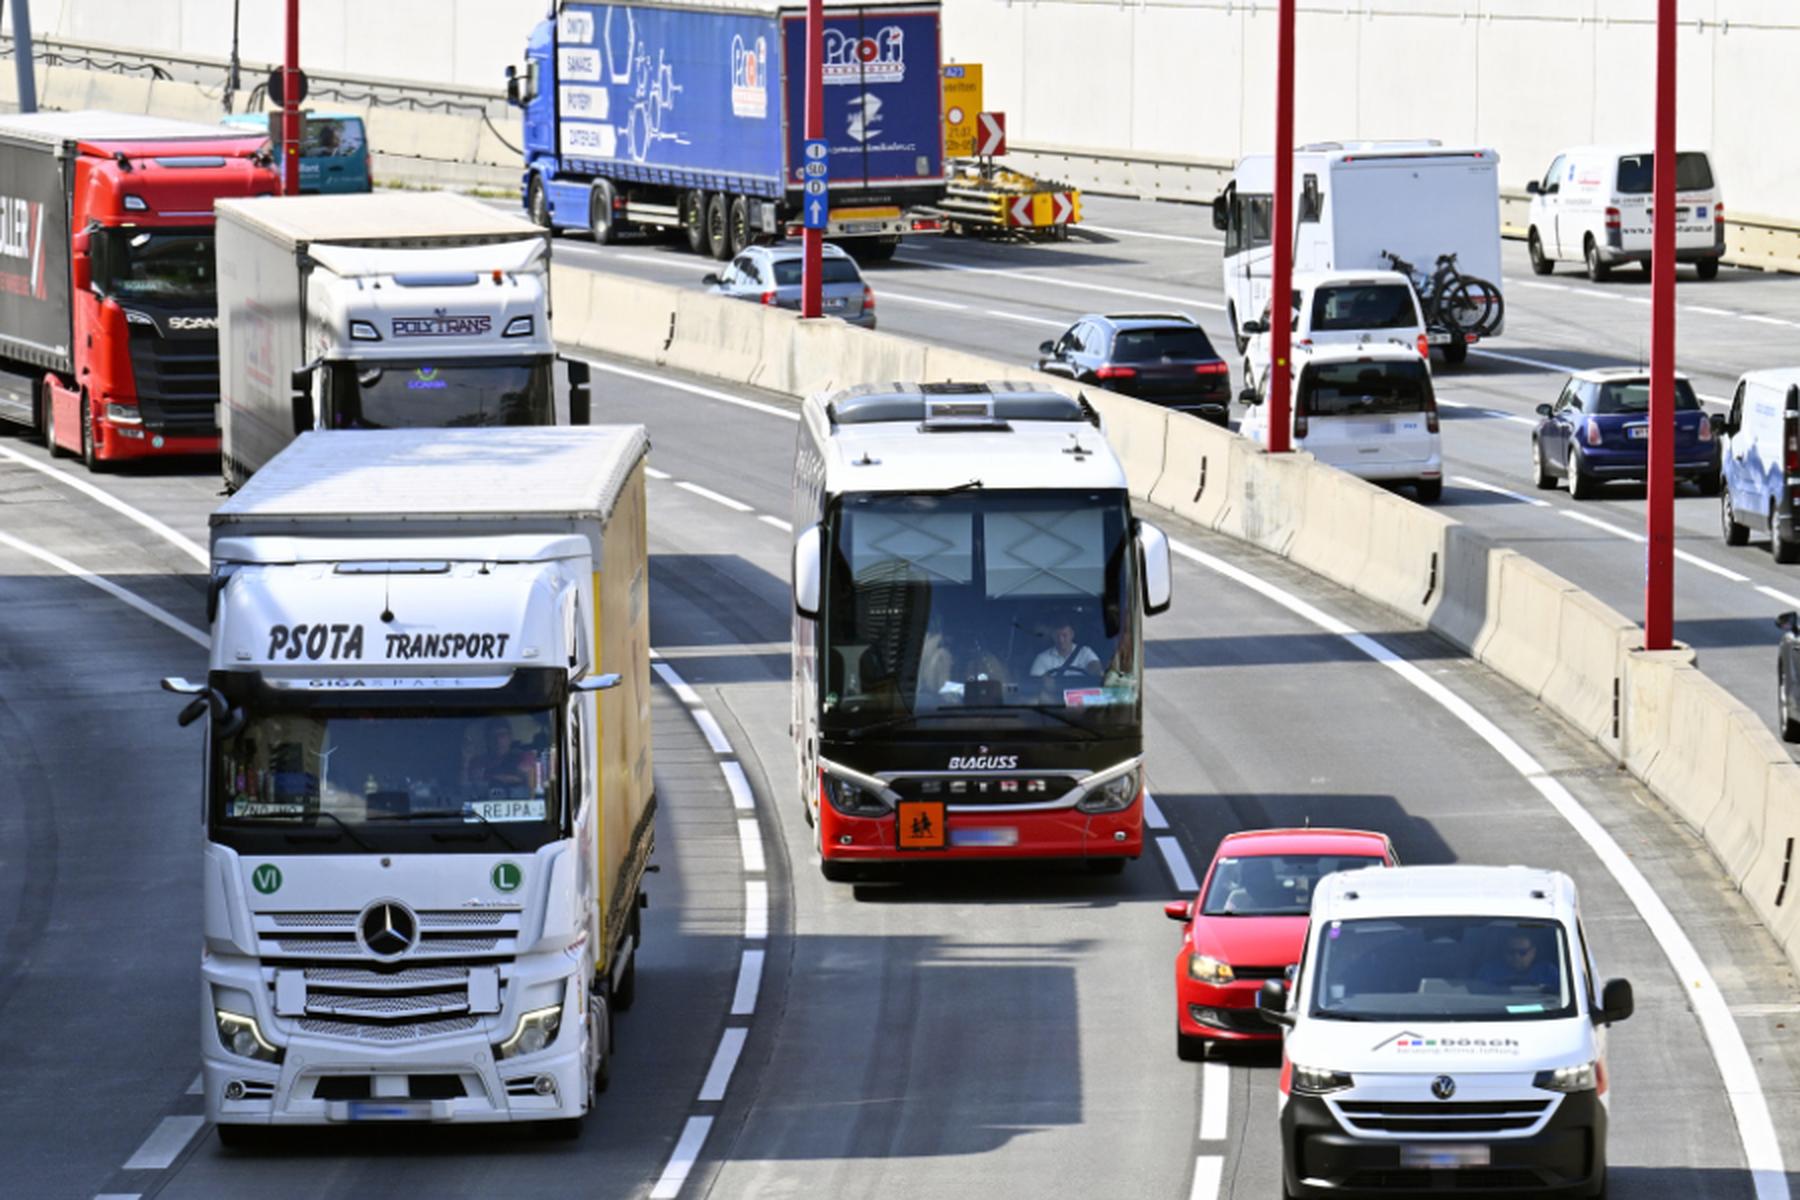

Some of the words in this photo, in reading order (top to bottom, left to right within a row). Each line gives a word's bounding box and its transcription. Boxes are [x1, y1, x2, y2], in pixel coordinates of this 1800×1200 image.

[823, 26, 903, 64] Profi
[732, 35, 767, 88] Profi
[267, 624, 364, 661] PSOTA
[385, 633, 509, 659] TRANSPORT
[948, 755, 1018, 770] BLAGUSS
[256, 869, 278, 890] VI
[499, 866, 515, 889] L
